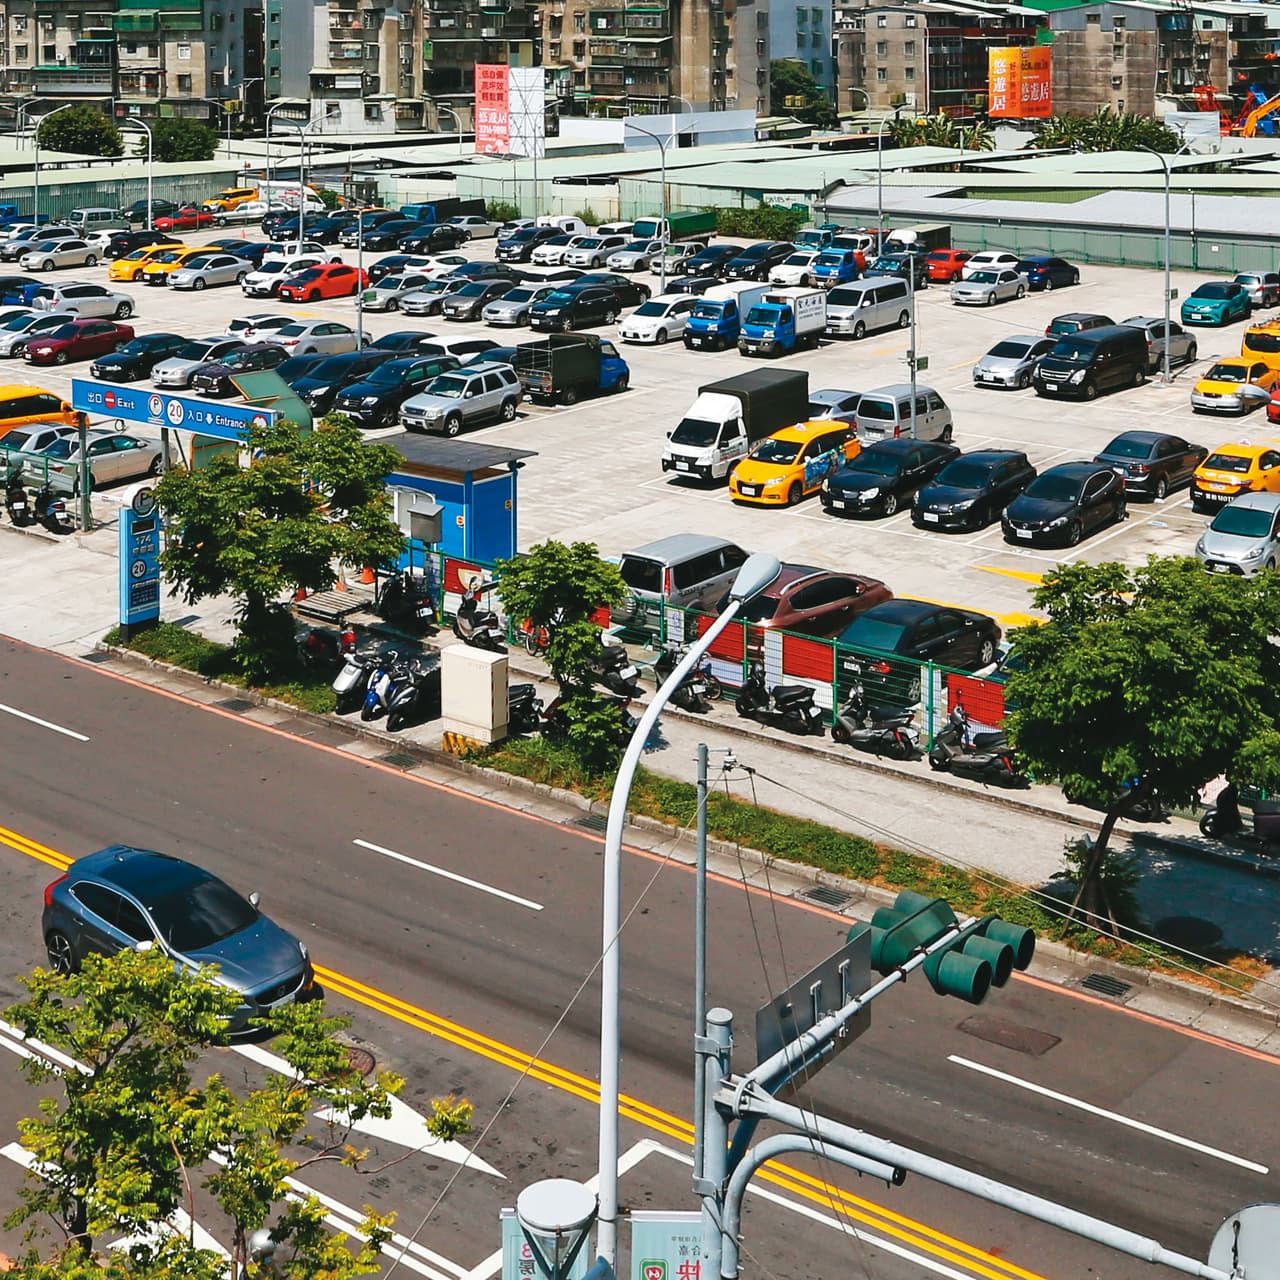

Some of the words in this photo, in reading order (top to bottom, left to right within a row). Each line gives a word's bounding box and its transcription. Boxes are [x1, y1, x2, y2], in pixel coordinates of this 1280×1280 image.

[989, 58, 1006, 112] 悠遊居
[87, 392, 103, 404] 出口
[117, 398, 135, 409] Exit
[169, 403, 183, 419] 20
[187, 410, 203, 422] 入口
